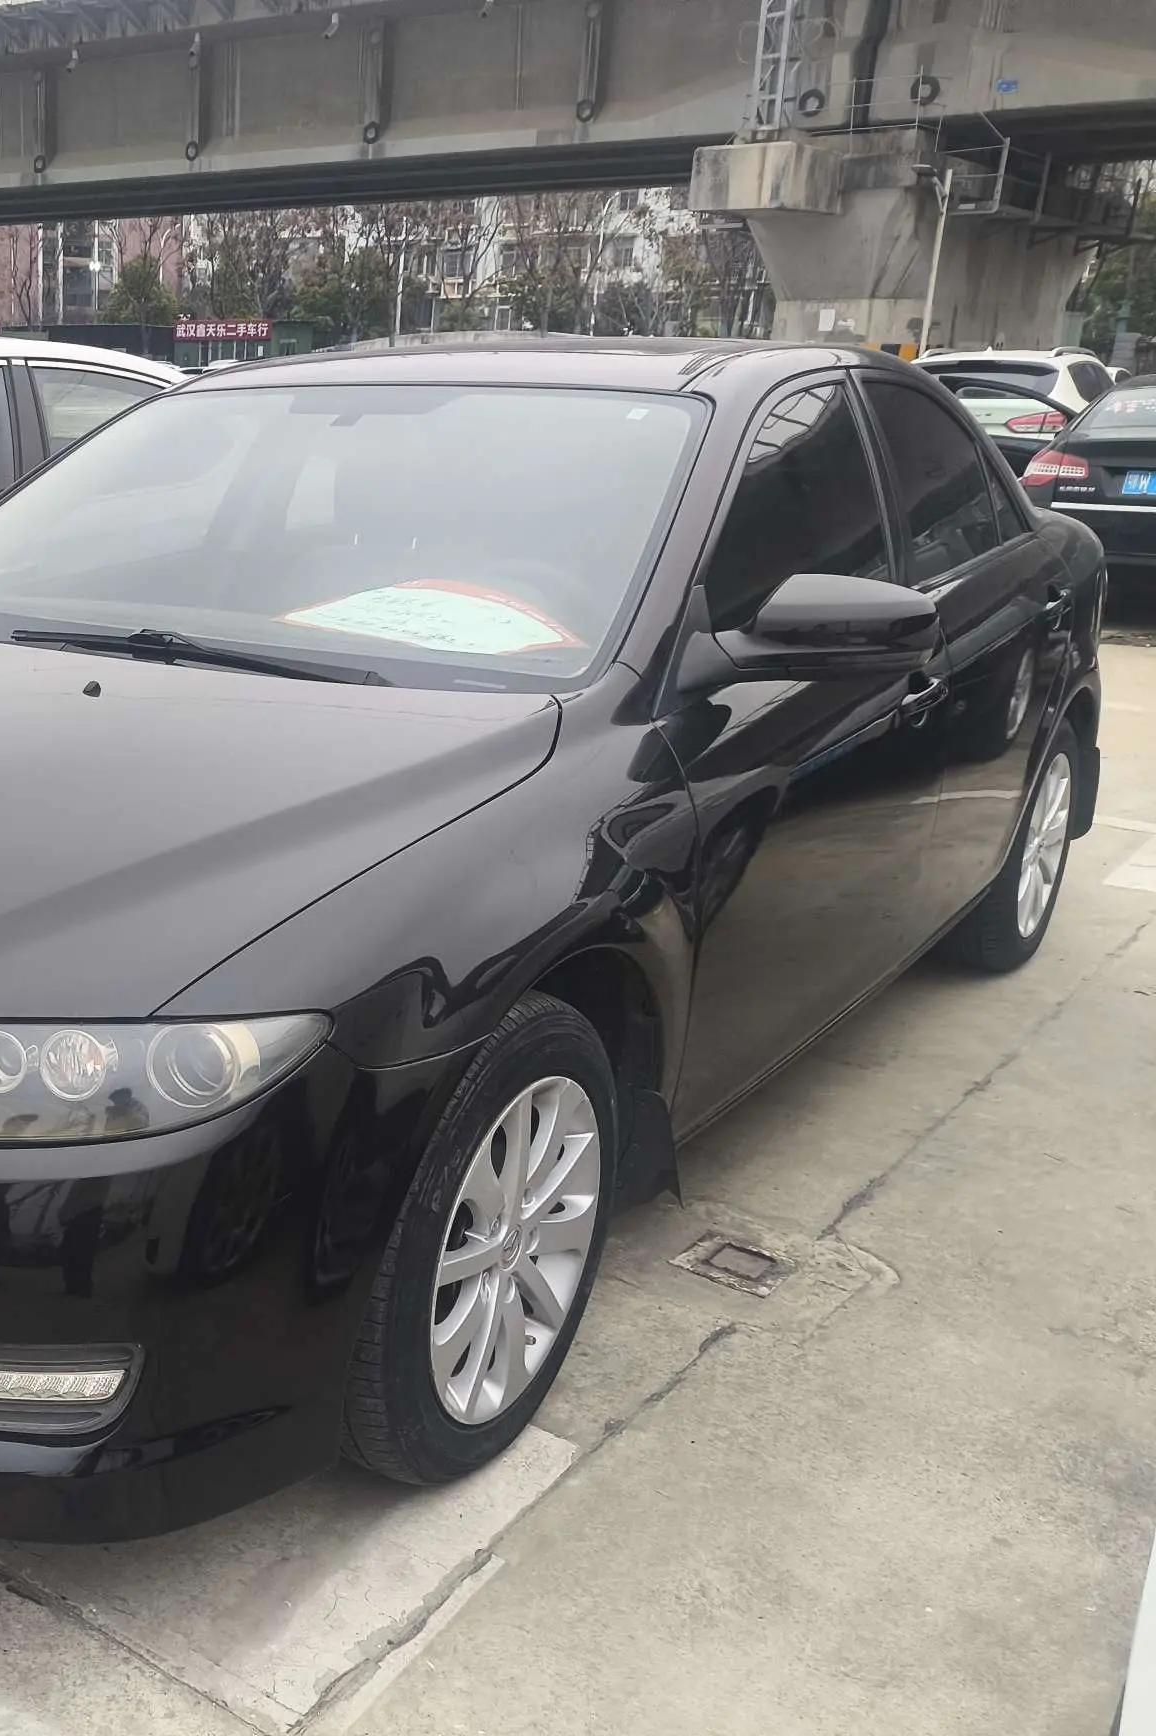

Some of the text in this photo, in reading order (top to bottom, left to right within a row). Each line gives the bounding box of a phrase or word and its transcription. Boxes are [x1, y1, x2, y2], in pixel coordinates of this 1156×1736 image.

[176, 322, 269, 338] 武汉鑫天乐二手车行
